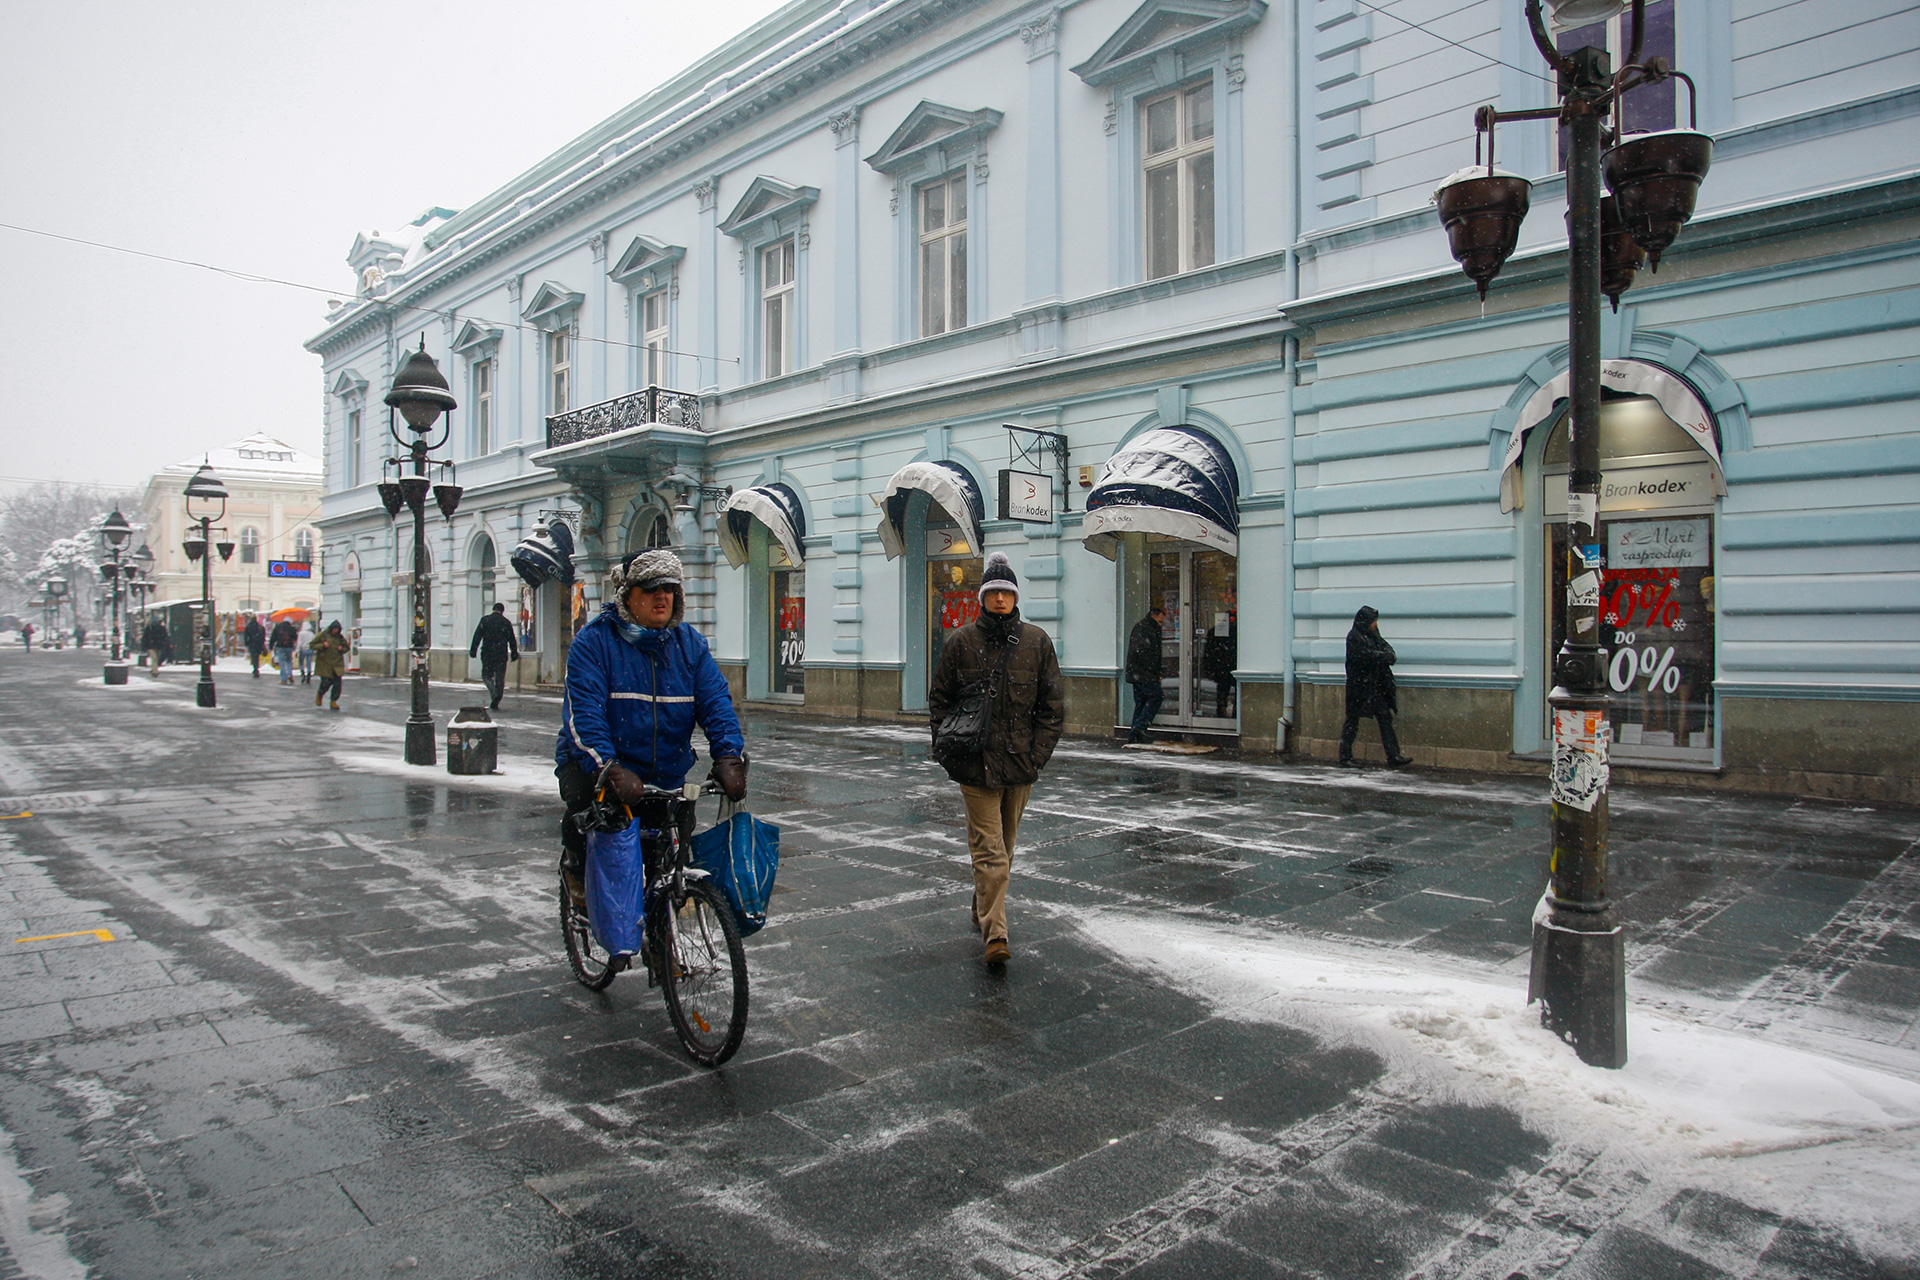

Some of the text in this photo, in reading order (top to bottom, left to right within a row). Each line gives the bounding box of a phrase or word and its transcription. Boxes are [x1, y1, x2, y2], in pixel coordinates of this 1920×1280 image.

[1602, 367, 1627, 379] kodex
[1605, 480, 1687, 498] Brankodex
[1010, 502, 1048, 517] Brankodex
[1636, 526, 1695, 545] Mart
[1622, 545, 1693, 564] rasprodaja
[1602, 567, 1680, 583] SPRODAJA
[1614, 630, 1636, 645] DO
[1608, 646, 1681, 694] 0%
